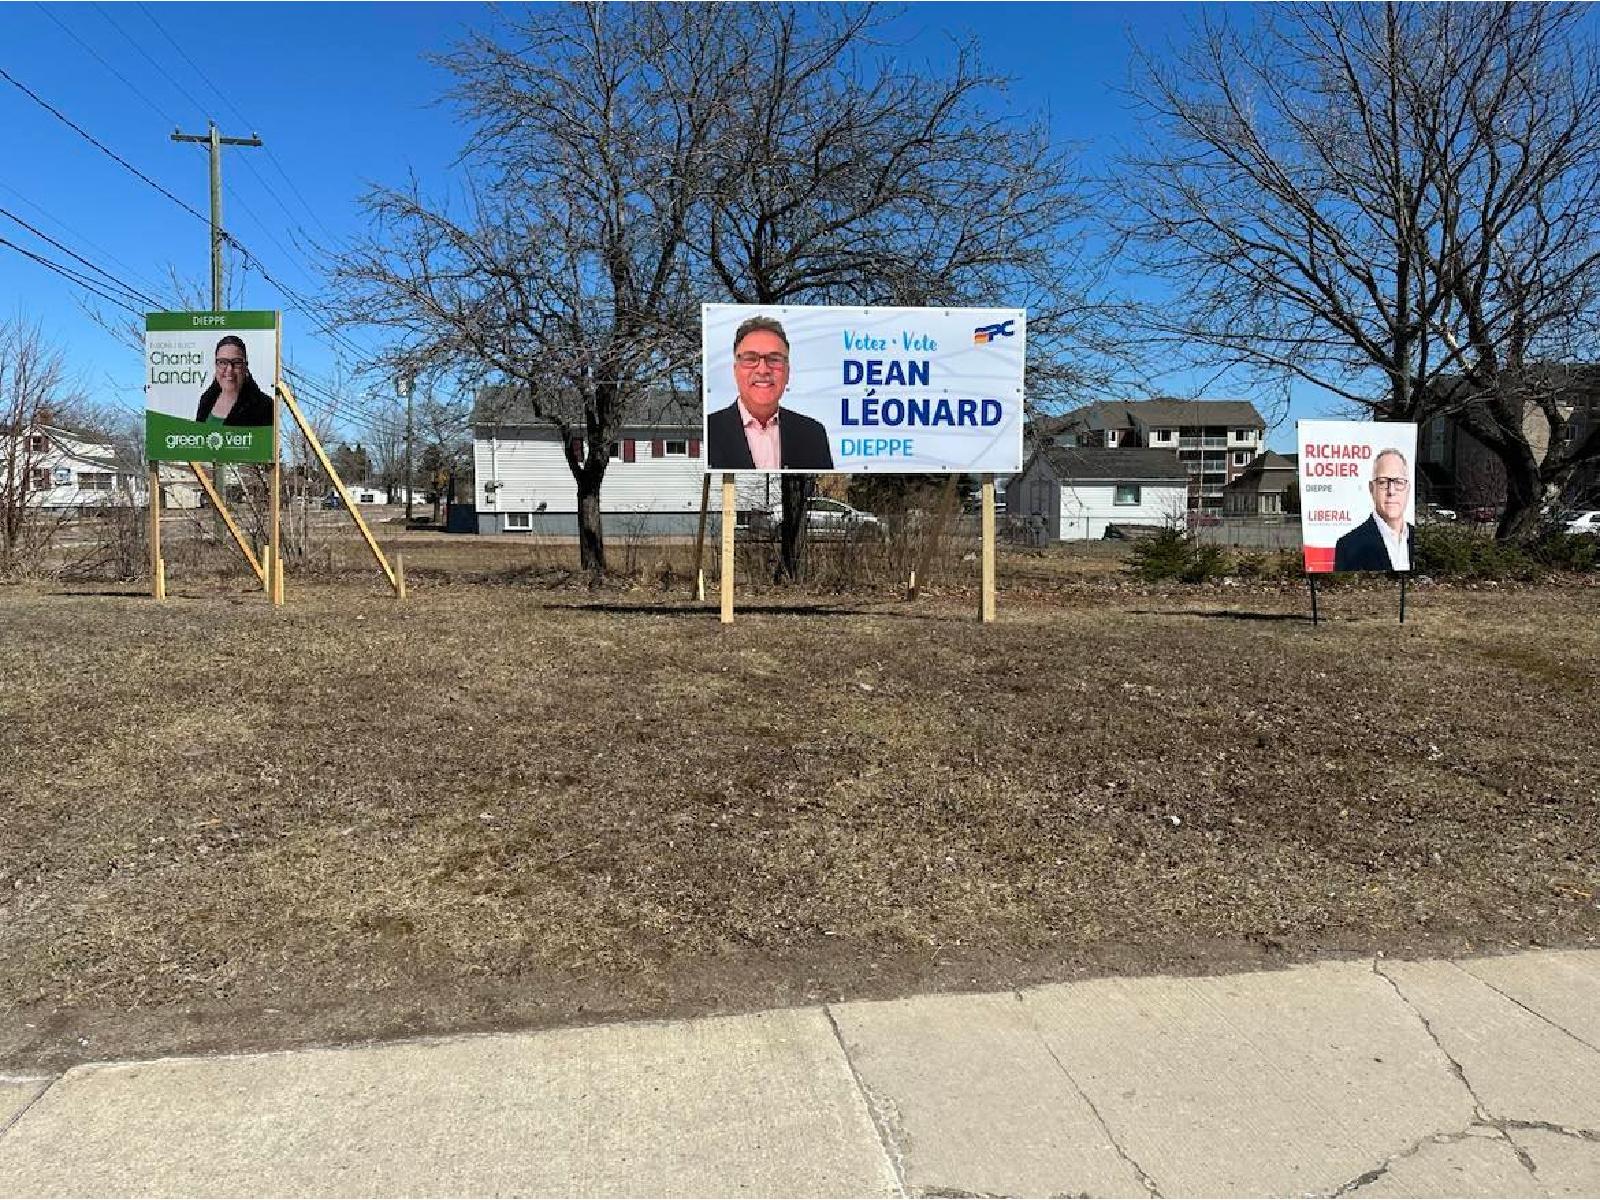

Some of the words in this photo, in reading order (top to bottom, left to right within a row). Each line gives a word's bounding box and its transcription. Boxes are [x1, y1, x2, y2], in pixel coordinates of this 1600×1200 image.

[192, 316, 225, 326] DIEPPE
[844, 330, 886, 351] Votez
[903, 331, 938, 351] Vote
[150, 351, 204, 365] Chantal
[151, 367, 207, 387] Landry
[843, 360, 930, 386] DEAN
[841, 388, 1003, 427] LÉONARD
[165, 435, 205, 448] green
[225, 432, 253, 446] vert
[841, 438, 914, 456] DIEPPE
[1305, 444, 1372, 459] RICHARD
[1305, 463, 1358, 477] LOSIER
[1305, 484, 1332, 492] DIEPPE
